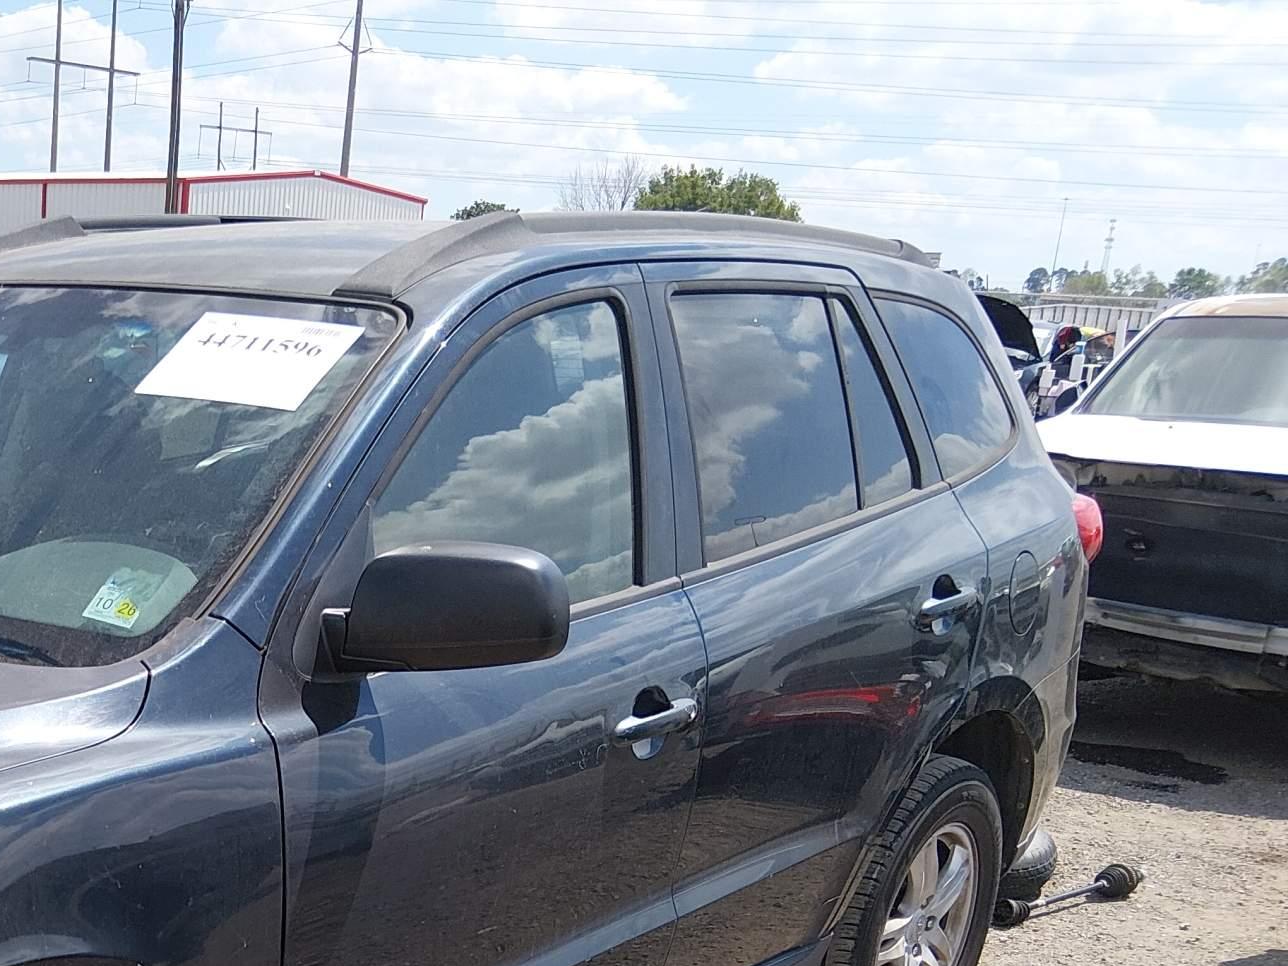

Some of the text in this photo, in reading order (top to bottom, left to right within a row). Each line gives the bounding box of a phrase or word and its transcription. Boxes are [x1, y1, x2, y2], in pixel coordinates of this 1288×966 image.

[197, 331, 323, 358] 44711596
[96, 597, 113, 609] 10
[118, 603, 136, 616] 26
